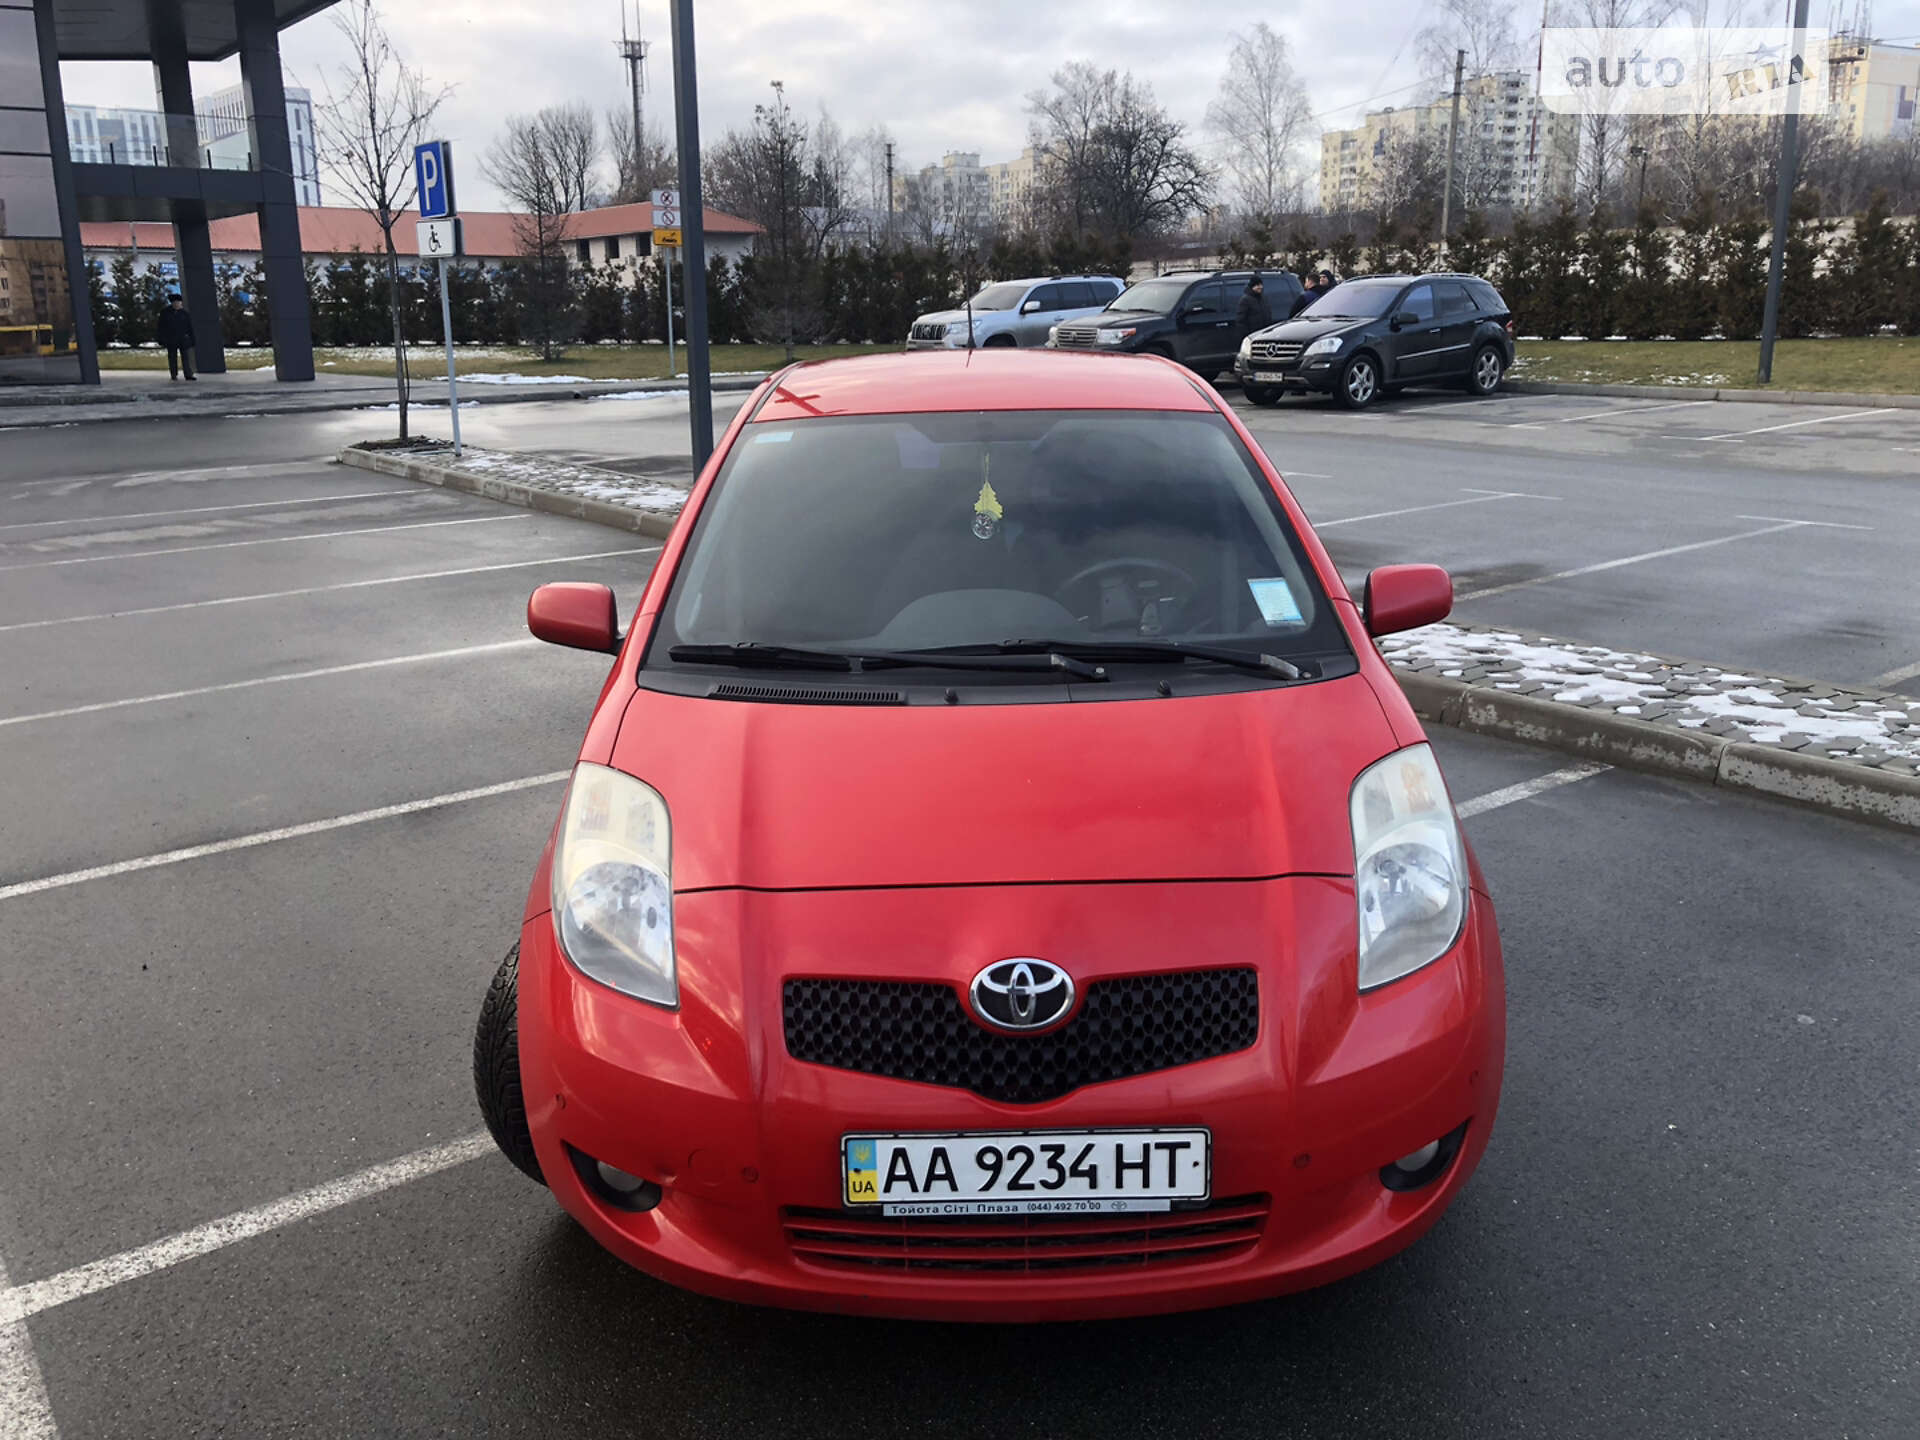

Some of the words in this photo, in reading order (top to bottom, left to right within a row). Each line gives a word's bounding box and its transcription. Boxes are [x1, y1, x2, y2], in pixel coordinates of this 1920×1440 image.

[421, 151, 438, 211] P
[883, 1146, 959, 1193] AA
[976, 1143, 1098, 1192] 9234
[1115, 1141, 1191, 1189] HT
[852, 1180, 875, 1193] UA
[976, 1203, 1019, 1213] Плаза
[1027, 1202, 1052, 1211] (044)
[1054, 1202, 1072, 1211] 492
[1075, 1202, 1087, 1210] 70
